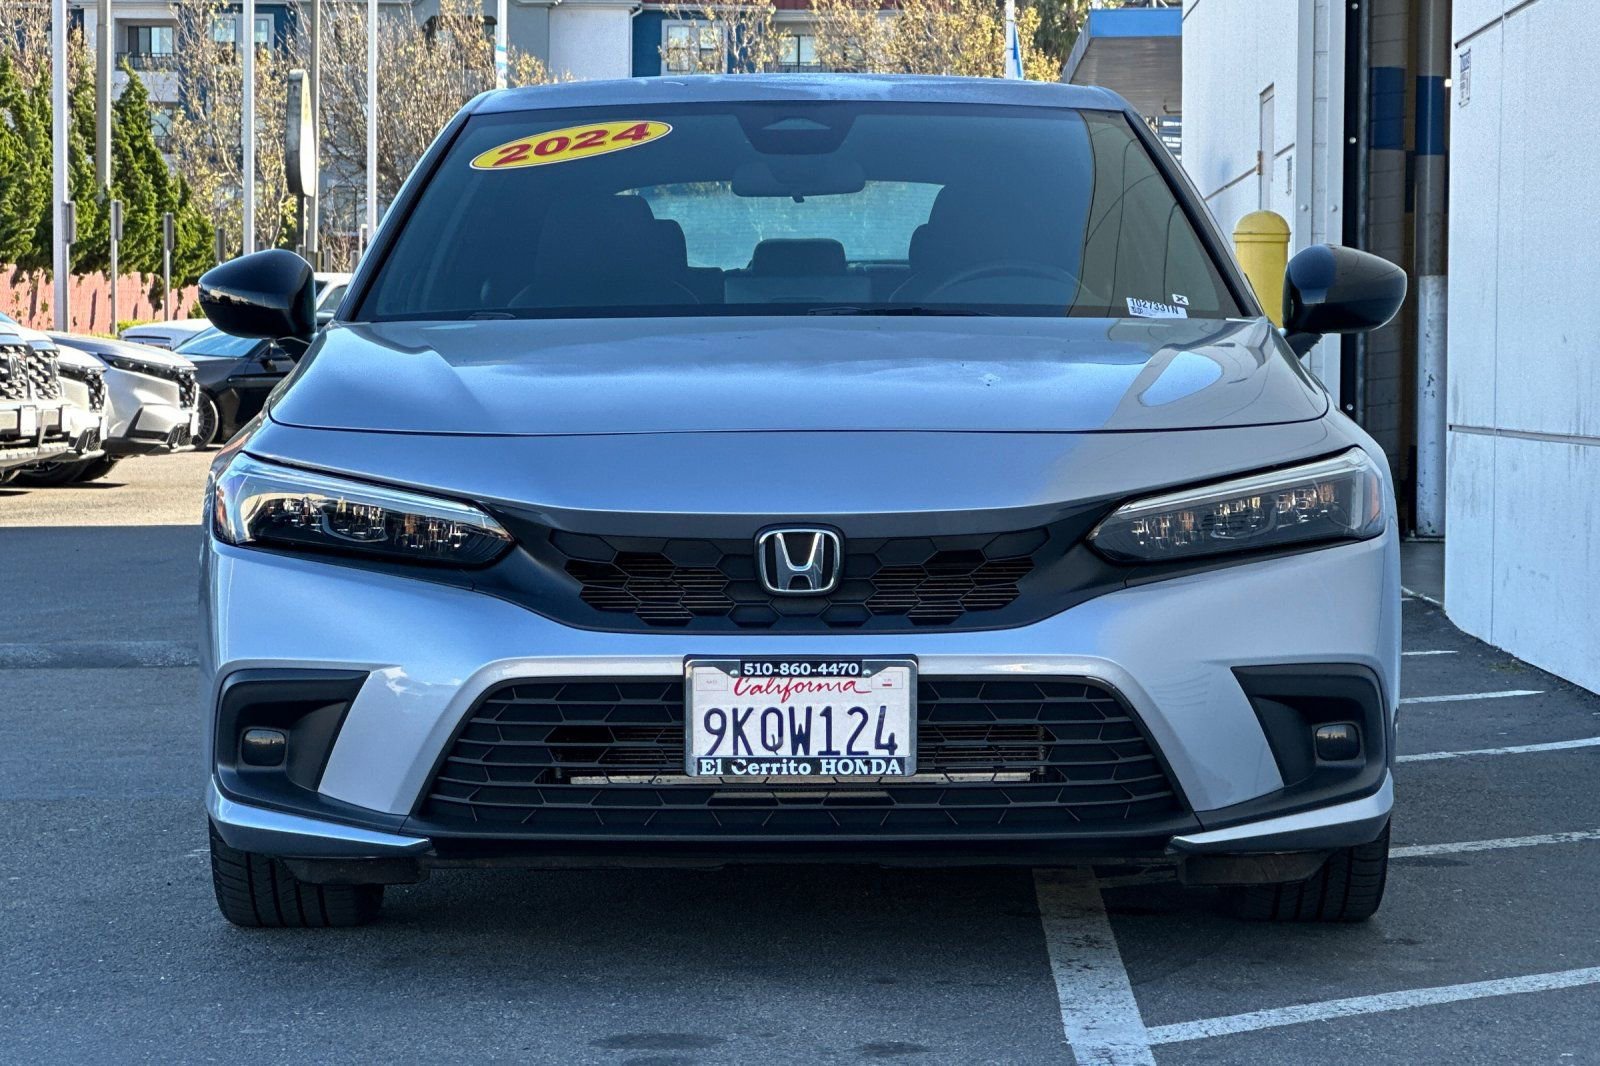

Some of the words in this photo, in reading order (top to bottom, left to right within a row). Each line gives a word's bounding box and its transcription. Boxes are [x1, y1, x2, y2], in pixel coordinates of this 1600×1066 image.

[492, 122, 651, 167] 2024
[743, 663, 859, 676] 510-860-4470
[734, 677, 872, 703] California
[703, 705, 898, 756] 9KQW124
[700, 758, 724, 775] El
[731, 758, 812, 775] Cerrito
[820, 758, 902, 775] HONDA
